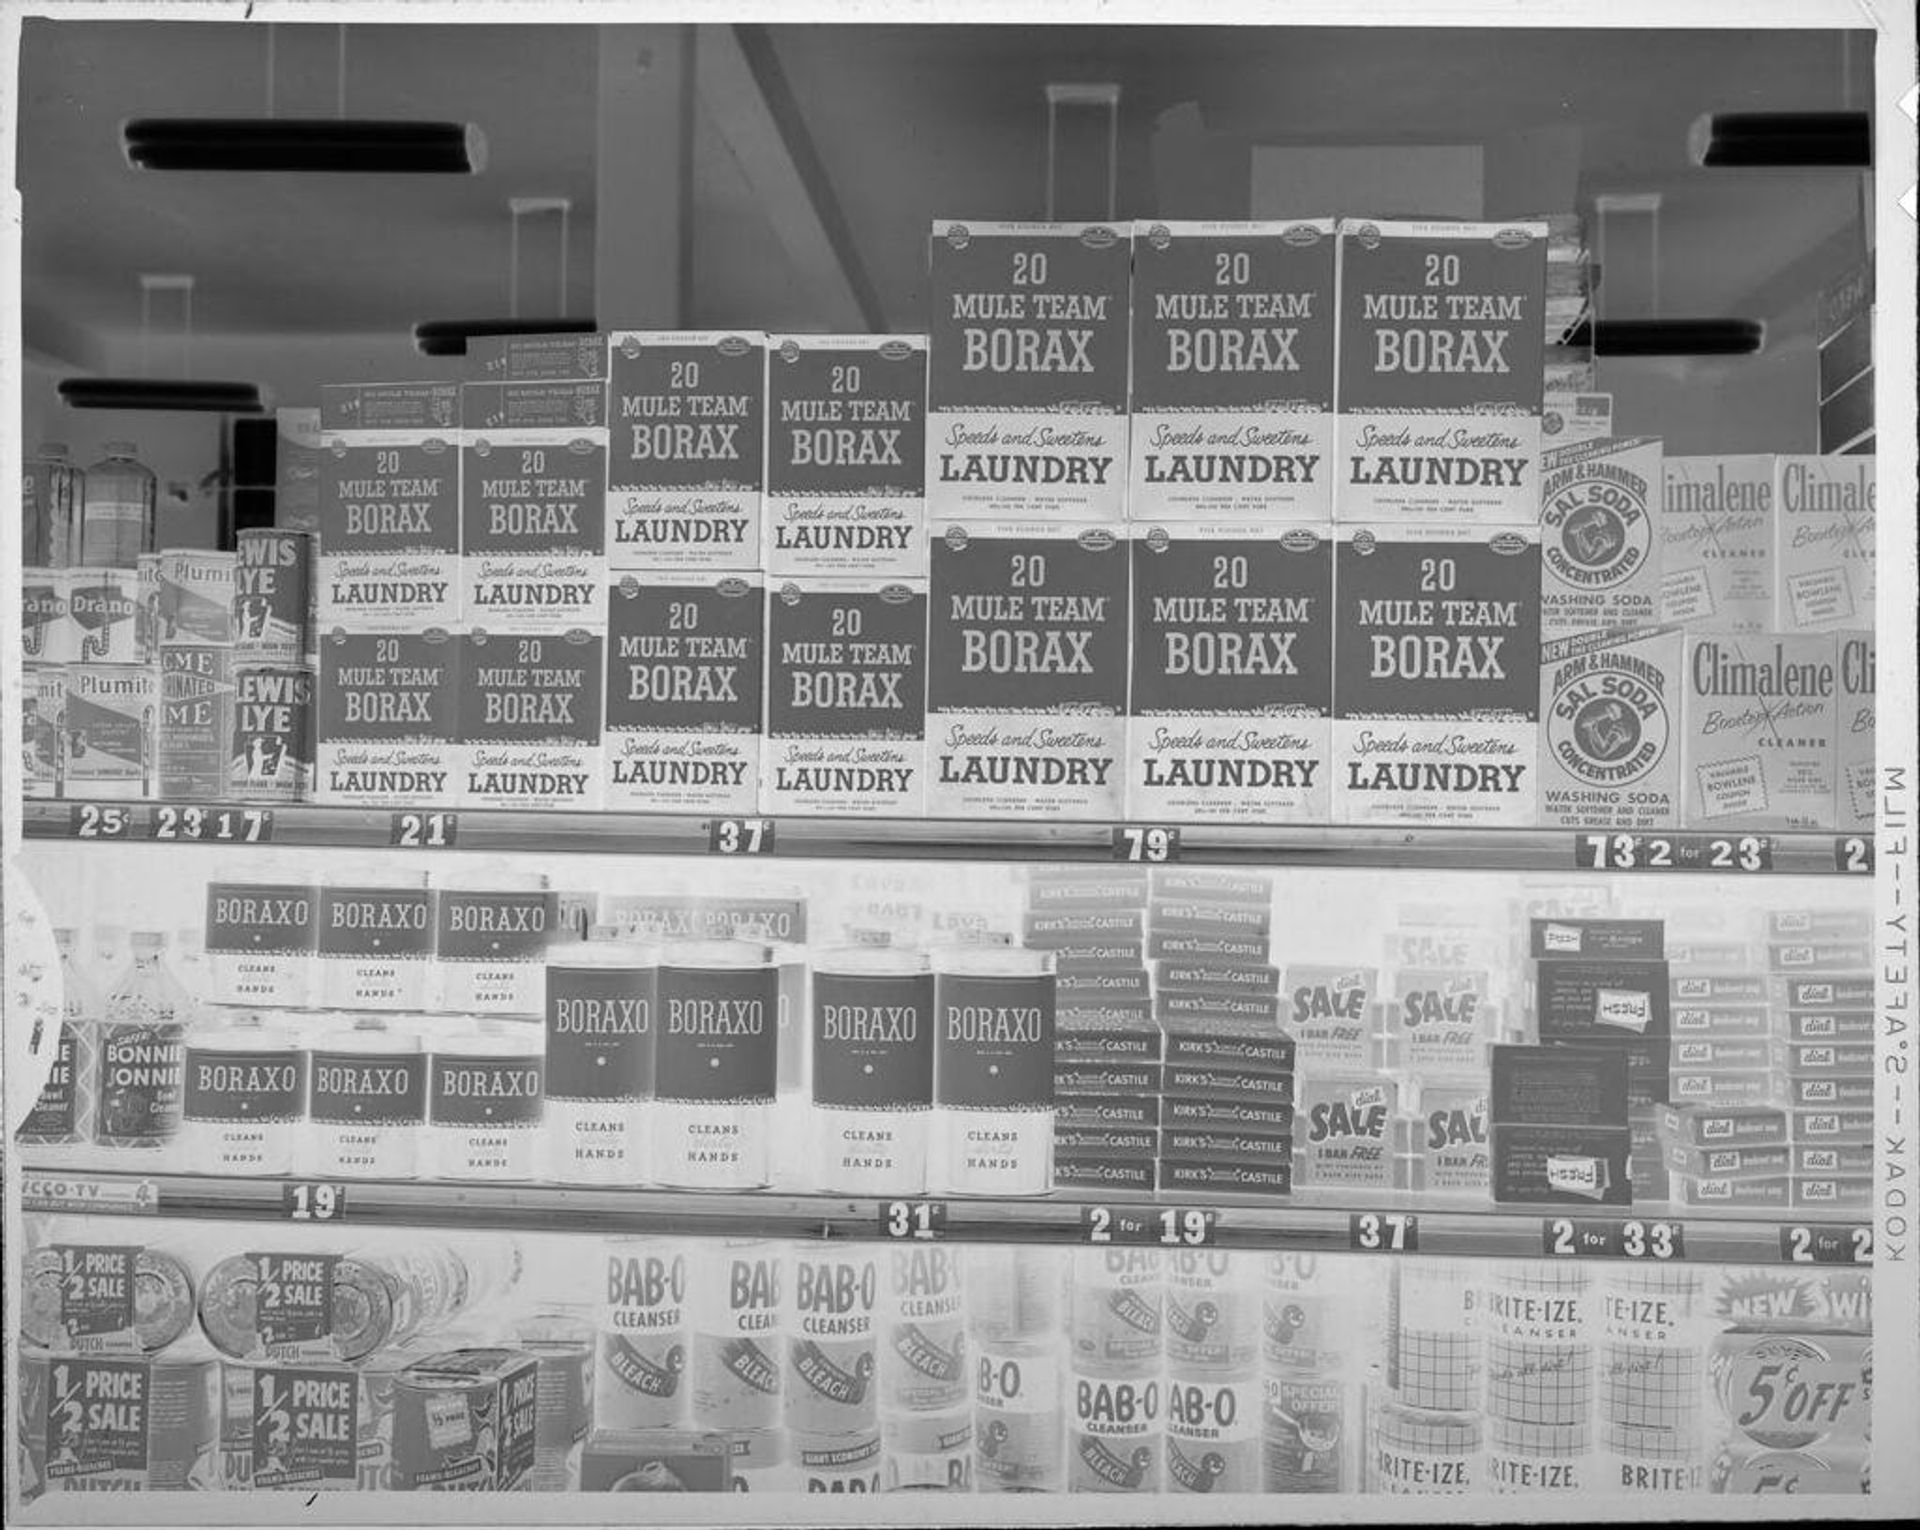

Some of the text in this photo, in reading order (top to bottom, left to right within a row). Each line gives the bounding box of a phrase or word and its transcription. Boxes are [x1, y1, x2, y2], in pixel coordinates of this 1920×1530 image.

[1013, 253, 1046, 284] 20
[1426, 254, 1459, 286] 20
[953, 294, 1106, 320] MULE TEAM
[1364, 295, 1522, 320] MULE TEAM
[963, 328, 1094, 372] BORAX
[1375, 329, 1509, 372] BORAX
[671, 362, 698, 388] 20
[622, 396, 681, 417] MULE
[687, 396, 748, 416] TEAM
[631, 424, 738, 460] BORAX
[945, 423, 1107, 448] Speeds and Sweetens
[378, 451, 399, 473] 20
[940, 455, 1113, 484] LAUNDRY
[1350, 456, 1529, 486] LAUNDRY
[339, 479, 441, 498] MULE TEAM
[1661, 464, 1771, 512] limalene
[346, 503, 432, 534] BORAX
[490, 504, 578, 535] BORAX
[622, 496, 741, 516] Speeds and Sweetens
[1545, 491, 1584, 527] SAL
[1588, 485, 1641, 527] SODA
[615, 519, 749, 542] LAUNDRY
[237, 540, 297, 566] EWIS
[1546, 547, 1640, 584] CONCENTRATED
[332, 582, 448, 603] LAUNDRY
[474, 584, 595, 604] LAUNDRY
[962, 630, 1093, 673] BORAX
[1165, 632, 1298, 675] BORAX
[1371, 635, 1505, 679] BORAX
[629, 665, 737, 701] BORAX
[1602, 653, 1665, 698] HAMMER
[1693, 642, 1833, 697] Climalene
[237, 676, 311, 703] LEWIS
[792, 672, 902, 708] BORAX
[1556, 676, 1658, 721] SAL SODA
[241, 705, 291, 732] LYE
[485, 693, 573, 723] BORAX
[613, 760, 747, 785] LAUNDRY
[939, 756, 1113, 785] LAUNDRY
[1144, 759, 1319, 787] LAUNDRY
[1557, 740, 1657, 781] CONCENTRATED
[468, 773, 589, 794] LAUNDRY
[776, 768, 913, 792] LAUNDRY
[1348, 762, 1526, 792] LAUNDRY
[1546, 791, 1669, 804] WASHING SODA
[1650, 840, 1673, 867] 2
[1680, 849, 1699, 860] for
[1844, 837, 1869, 871] 2
[215, 898, 308, 925] BORAXO
[450, 906, 544, 931] BORAXO
[237, 985, 274, 993] HANDS
[1231, 973, 1270, 984] CASTILE
[556, 999, 648, 1033] BORAXO
[668, 999, 762, 1034] BORAXO
[1293, 986, 1366, 1023] SALE
[1405, 991, 1476, 1026] SALE
[824, 1005, 916, 1041] BORAXO
[947, 1006, 1040, 1041] BORAXO
[198, 1065, 295, 1092] BORAXO
[443, 1071, 540, 1096] BORAXO
[576, 1122, 624, 1132] CLEANS
[1239, 1108, 1282, 1122] CASTILE
[1309, 1102, 1387, 1141] SALE
[843, 1130, 891, 1141] CLEANS
[1428, 1110, 1486, 1149] SAL
[576, 1149, 623, 1159] HANDS
[843, 1158, 891, 1168] HANDS
[1240, 1172, 1283, 1185] CASTILE
[1090, 1209, 1112, 1241] 2
[1120, 1219, 1141, 1232] for
[1553, 1219, 1576, 1253] 2
[1583, 1232, 1605, 1245] for
[1789, 1227, 1873, 1261] 2 for 2
[87, 1254, 124, 1273] PRICE
[89, 1278, 124, 1298] SALE
[614, 1310, 680, 1327] CLEANSER
[803, 1316, 871, 1334] CLEANSER
[87, 1371, 142, 1399] PRICE
[293, 1381, 349, 1408] PRICE
[1170, 1384, 1235, 1427] AB-O
[1784, 1380, 1854, 1424] OFF
[89, 1404, 140, 1431] SALE
[297, 1413, 349, 1440] SALE
[1087, 1422, 1147, 1434] CLEANSER
